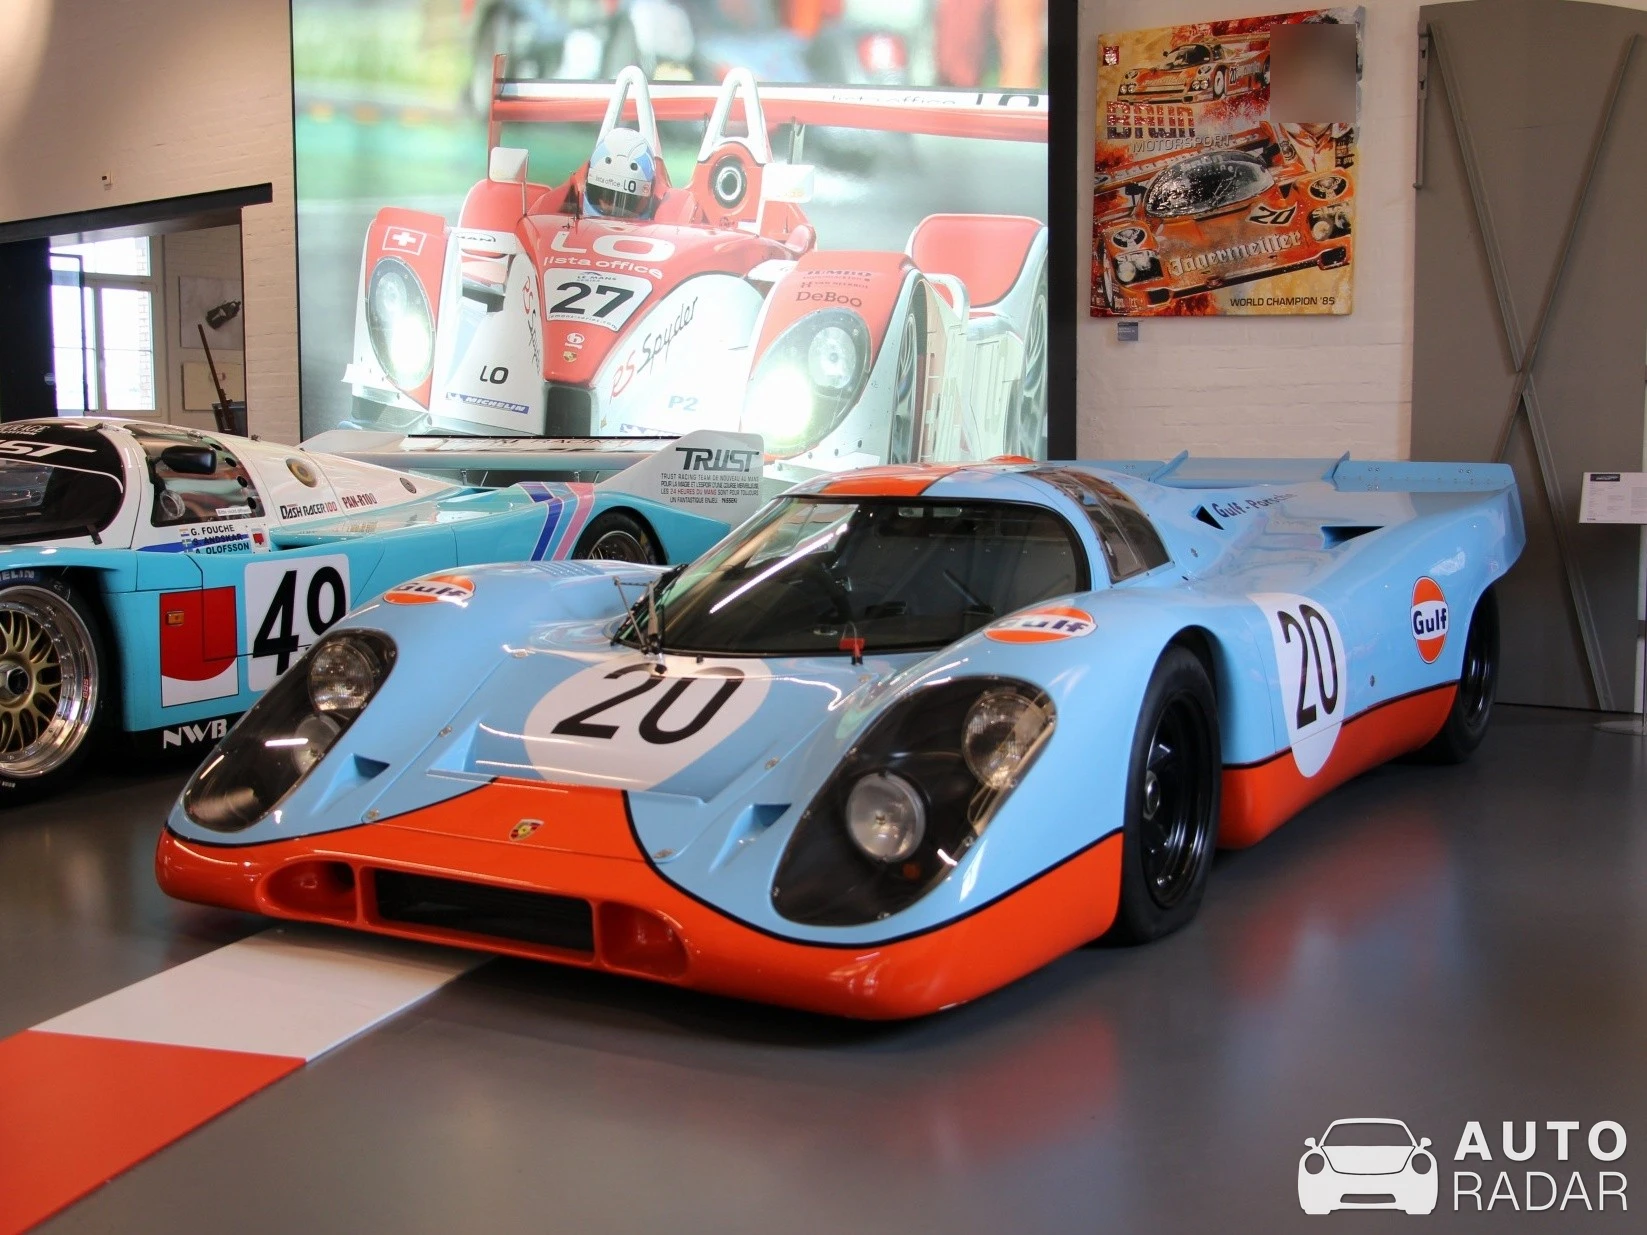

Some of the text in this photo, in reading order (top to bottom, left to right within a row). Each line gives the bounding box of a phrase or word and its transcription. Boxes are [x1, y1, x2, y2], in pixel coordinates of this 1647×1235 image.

[1131, 132, 1234, 153] MOTORSPORT
[623, 179, 637, 193] LO
[1250, 206, 1296, 225] 20
[550, 231, 676, 262] LO
[543, 256, 663, 280] lista office
[549, 281, 635, 319] 27
[1230, 298, 1266, 308] WORLD
[1266, 296, 1318, 306] CHAMPION
[479, 365, 509, 385] LO
[465, 395, 529, 415] MICHELIN
[667, 395, 699, 412] P2
[676, 446, 760, 473] TRUST
[678, 473, 697, 481] RACING
[342, 492, 378, 509] PAN-R100
[1211, 502, 1247, 518] Gulf
[190, 524, 236, 536] G. FOUCHE
[203, 534, 244, 545] ANDSKAR
[206, 542, 250, 554] OLOFSSON
[0, 570, 35, 581] ELIN
[1412, 608, 1447, 635] Gulf
[1277, 604, 1339, 730] 20
[550, 662, 746, 744] 20
[163, 718, 228, 749] NWB
